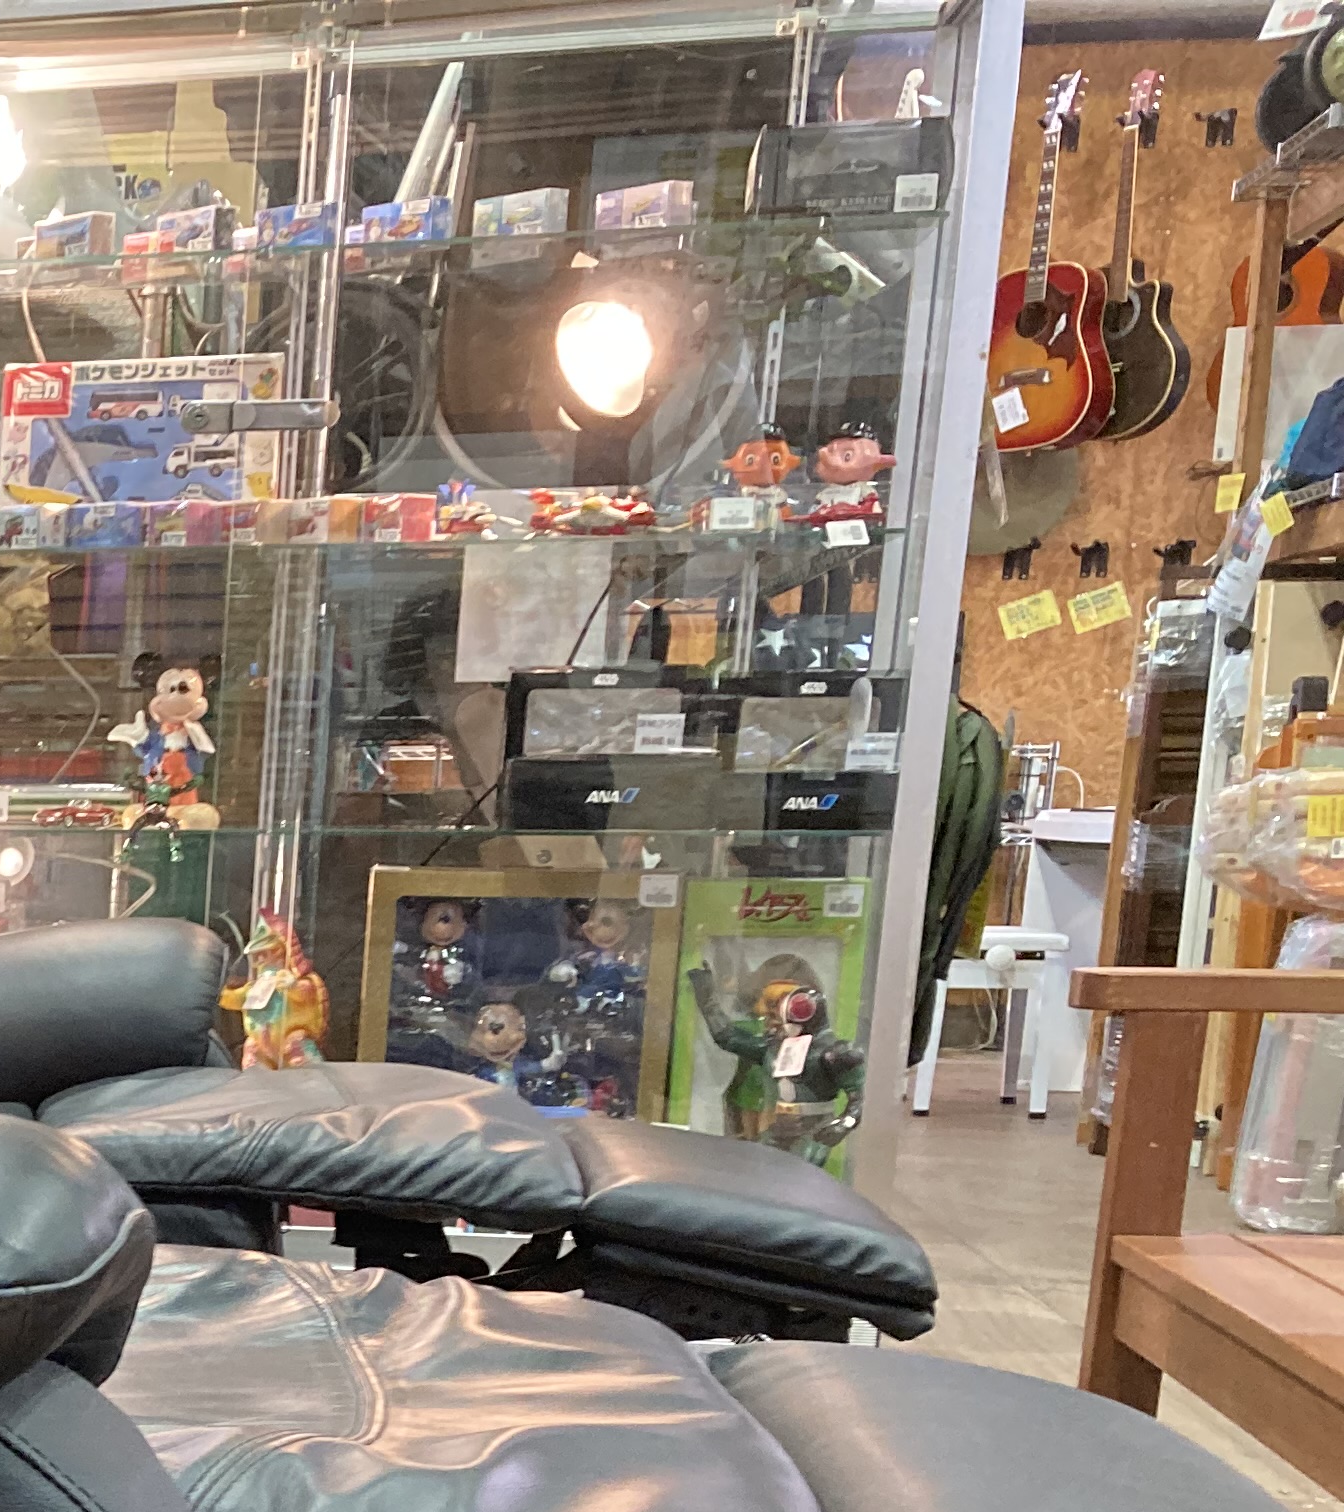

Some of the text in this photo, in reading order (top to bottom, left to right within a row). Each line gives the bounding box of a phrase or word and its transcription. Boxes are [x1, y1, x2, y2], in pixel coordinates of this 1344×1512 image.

[74, 361, 207, 382] ポケモンジェット
[15, 377, 62, 401] トミカ
[584, 790, 620, 803] ANA
[782, 796, 818, 810] ANA
